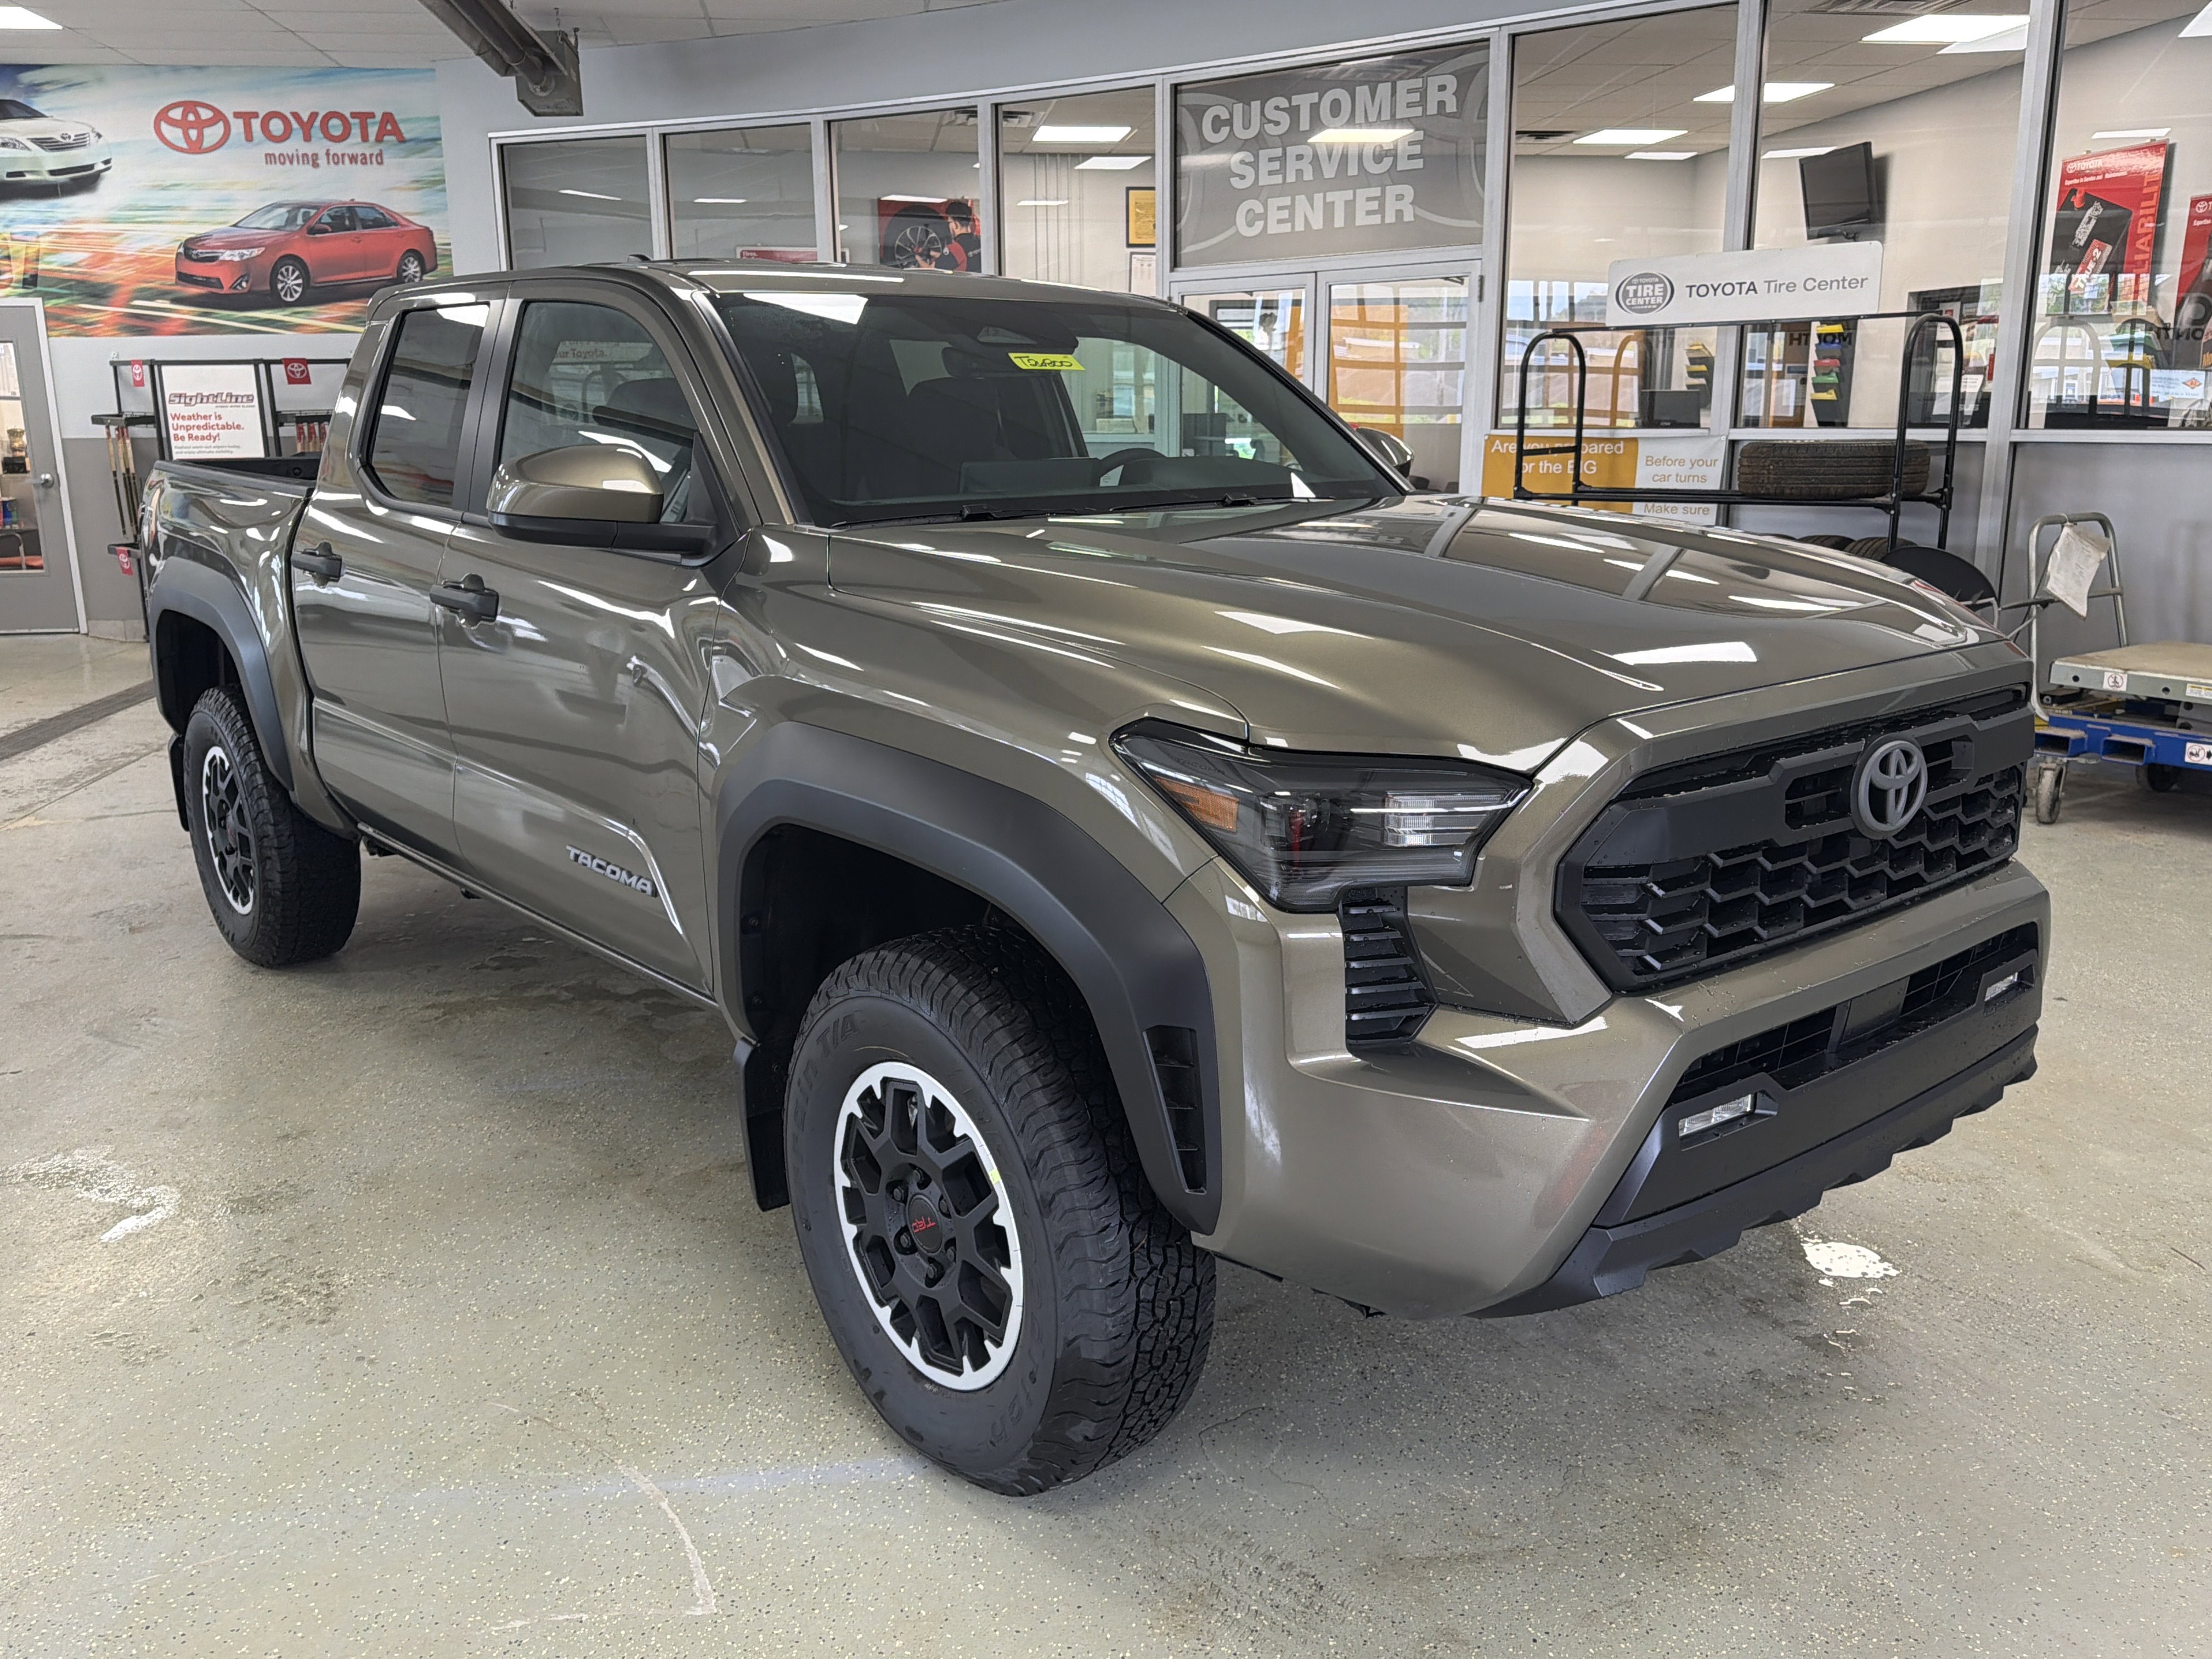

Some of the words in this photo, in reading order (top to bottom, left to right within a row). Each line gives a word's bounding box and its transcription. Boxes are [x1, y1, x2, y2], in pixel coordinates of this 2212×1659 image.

[1202, 75, 1457, 143] CUSTOMER
[233, 111, 406, 143] TOYOTA
[264, 149, 320, 168] moving
[325, 149, 384, 165] forward
[1229, 131, 1424, 189] SERVICE
[1235, 185, 1415, 237] CENTER
[1626, 284, 1664, 297] TIRE
[1685, 281, 1758, 298] TOYOTA
[1764, 279, 1797, 294] Tire
[1803, 276, 1869, 292] Center
[1626, 297, 1663, 306] CENTER
[170, 413, 212, 421] Weather
[215, 411, 222, 421] is
[172, 422, 245, 432] Unpredictable.
[188, 432, 221, 443] Ready!
[1491, 439, 1517, 454] Are
[1522, 462, 1536, 473] or
[1539, 460, 1562, 473] the
[1646, 456, 1685, 467] Before
[1690, 458, 1718, 470] your
[1652, 473, 1672, 482] car
[1675, 472, 1707, 483] turns
[1644, 503, 1680, 515] Make
[1683, 505, 1710, 516] sure
[566, 845, 655, 896] TACOMA
[912, 1216, 936, 1233] TRD
